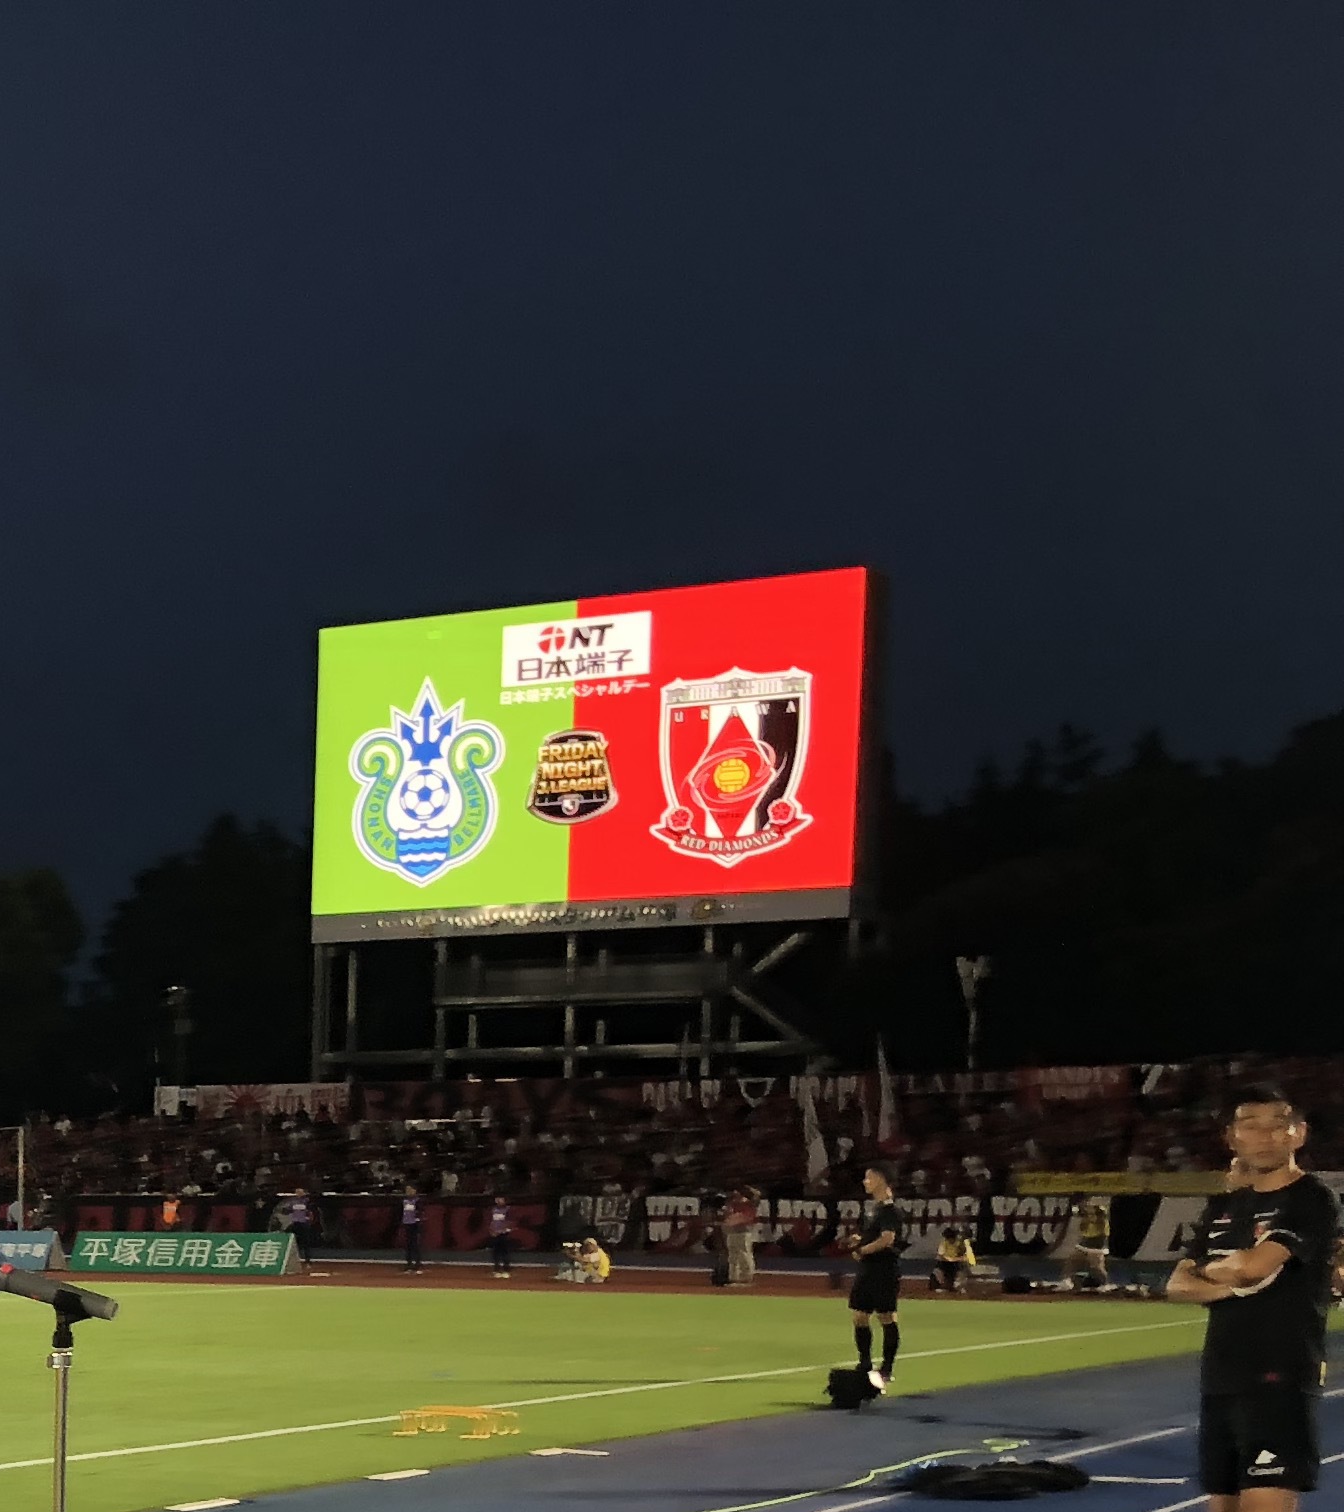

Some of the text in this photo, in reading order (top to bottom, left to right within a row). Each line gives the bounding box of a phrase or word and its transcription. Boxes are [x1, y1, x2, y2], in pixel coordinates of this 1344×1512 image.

[569, 623, 614, 649] NT
[517, 649, 634, 681] 日本端子
[499, 679, 650, 705] 日本端子スペシャルデー
[674, 700, 796, 723] URAWA
[538, 741, 609, 762] FRIDAY
[540, 759, 604, 780] NIGHT
[367, 777, 394, 851] SHONAN
[680, 829, 779, 852] RED DIAMONDS
[79, 1238, 282, 1269] 平塚信用金庫
